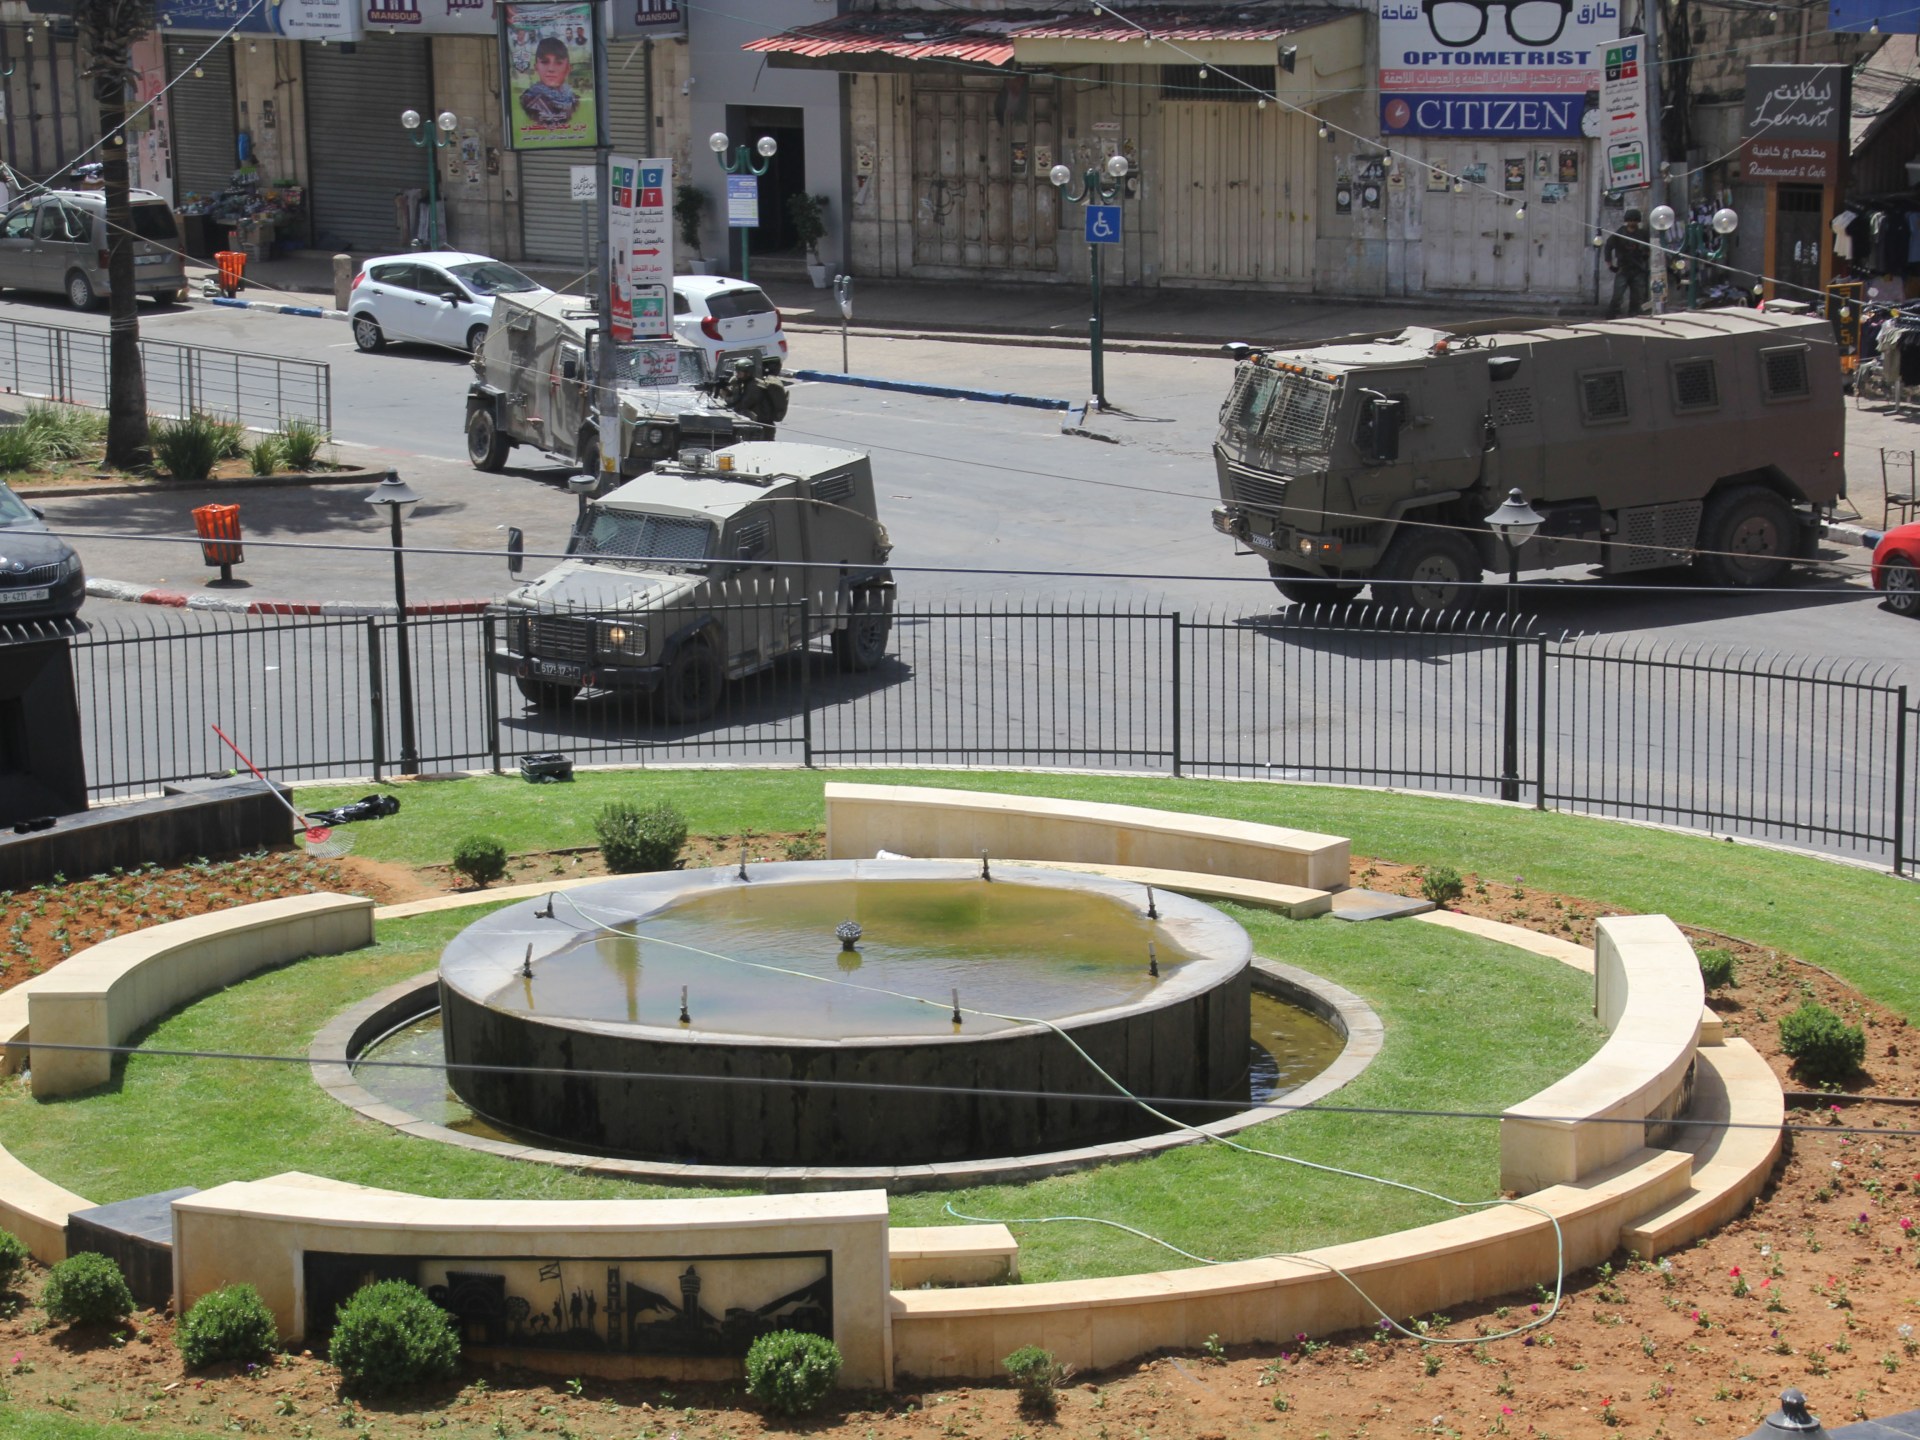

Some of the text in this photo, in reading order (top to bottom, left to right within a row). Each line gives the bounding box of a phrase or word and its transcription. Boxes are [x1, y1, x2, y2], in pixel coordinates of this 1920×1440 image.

[371, 11, 420, 21] MANSOUR
[637, 12, 679, 22] MANSOUR
[1382, 6, 1418, 20] تفاحة
[1577, 2, 1617, 24] طارق
[1403, 50, 1591, 65] OPTOMETRIST
[1383, 71, 1414, 85] اللاصقة
[1417, 71, 1454, 86] العدسات
[1774, 82, 1831, 105] ليفانت
[1416, 100, 1573, 130] CITIZEN
[1749, 91, 1835, 127] Levant
[1792, 147, 1826, 158] مطعم
[1749, 162, 1798, 176] Restaurant
[648, 173, 656, 183] C
[648, 192, 656, 203] T
